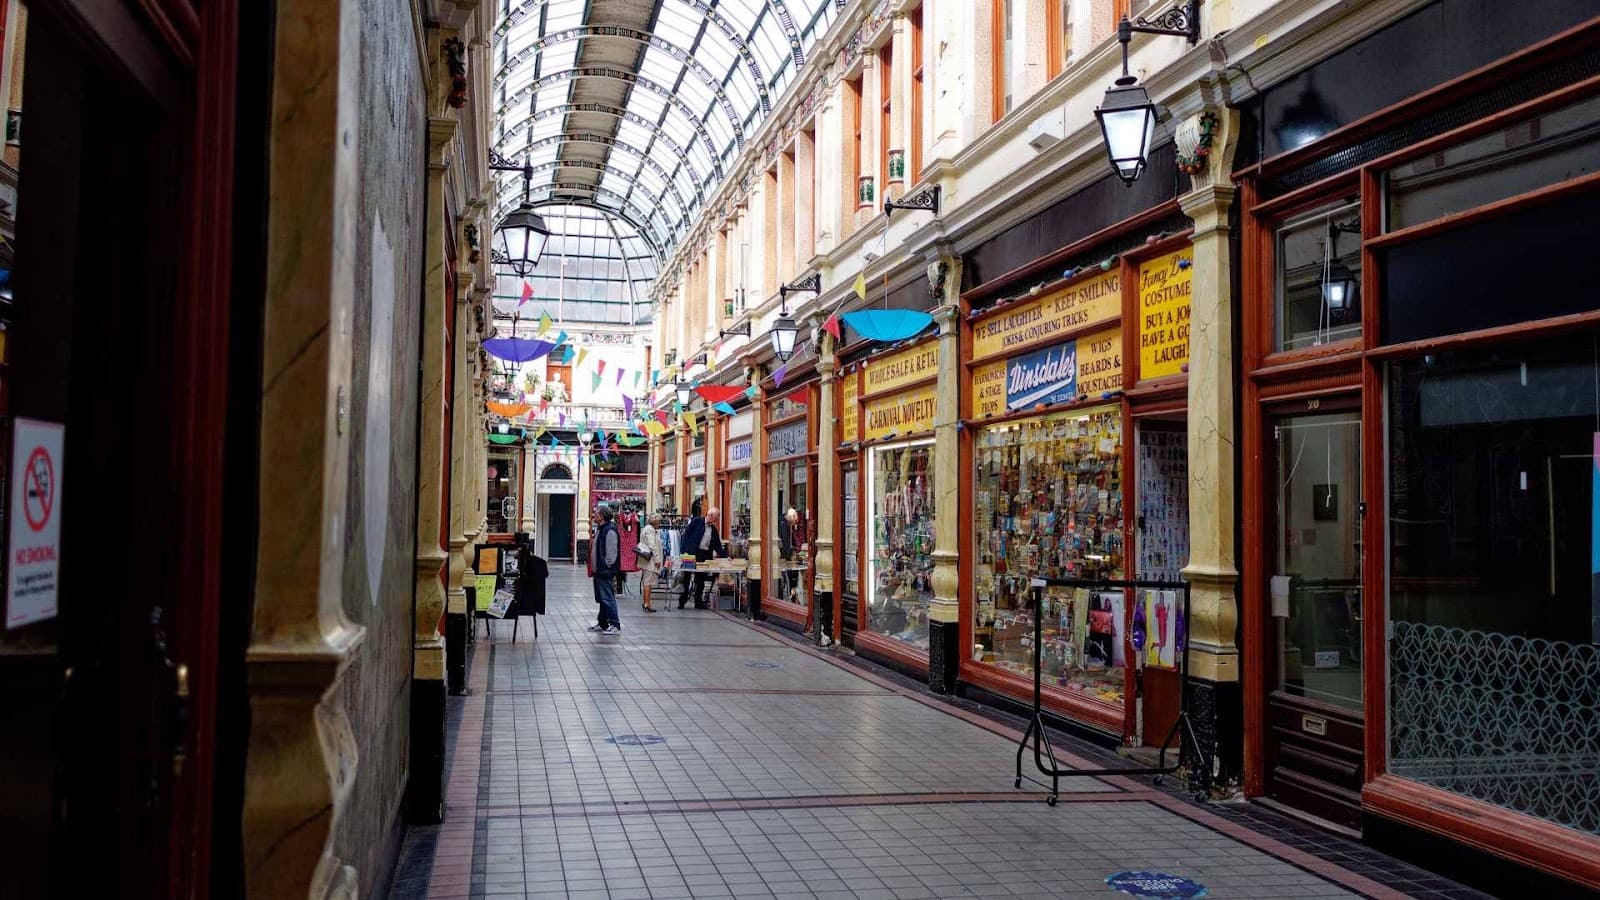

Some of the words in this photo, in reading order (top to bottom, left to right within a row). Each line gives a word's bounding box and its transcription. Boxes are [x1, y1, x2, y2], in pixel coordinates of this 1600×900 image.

[1141, 267, 1168, 291] Fancy
[1144, 280, 1191, 307] COSTUME
[975, 325, 987, 340] WE
[987, 319, 1002, 337] SELL
[1003, 304, 1043, 331] LAUGHTER
[1054, 292, 1077, 313] KEEP
[1024, 321, 1061, 341] CONJURING
[1061, 309, 1088, 328] TRICKS
[1146, 311, 1164, 330] BUY
[1166, 310, 1173, 325] A
[1091, 339, 1112, 354] WIGS
[1142, 330, 1165, 348] HAVE
[1168, 327, 1175, 343] A
[869, 361, 909, 385] WHOLESALE
[1008, 346, 1075, 396] Dinsdales
[1080, 357, 1112, 377] BEARDS
[1113, 355, 1121, 367] &
[980, 391, 985, 399] &
[985, 383, 1002, 397] STAGE
[870, 404, 901, 429] CARNIVAL
[902, 398, 934, 423] NOVELTY
[981, 399, 998, 413] PROPS
[1307, 399, 1320, 410] 20
[16, 548, 27, 565] NO
[27, 545, 56, 563] SMOKING
